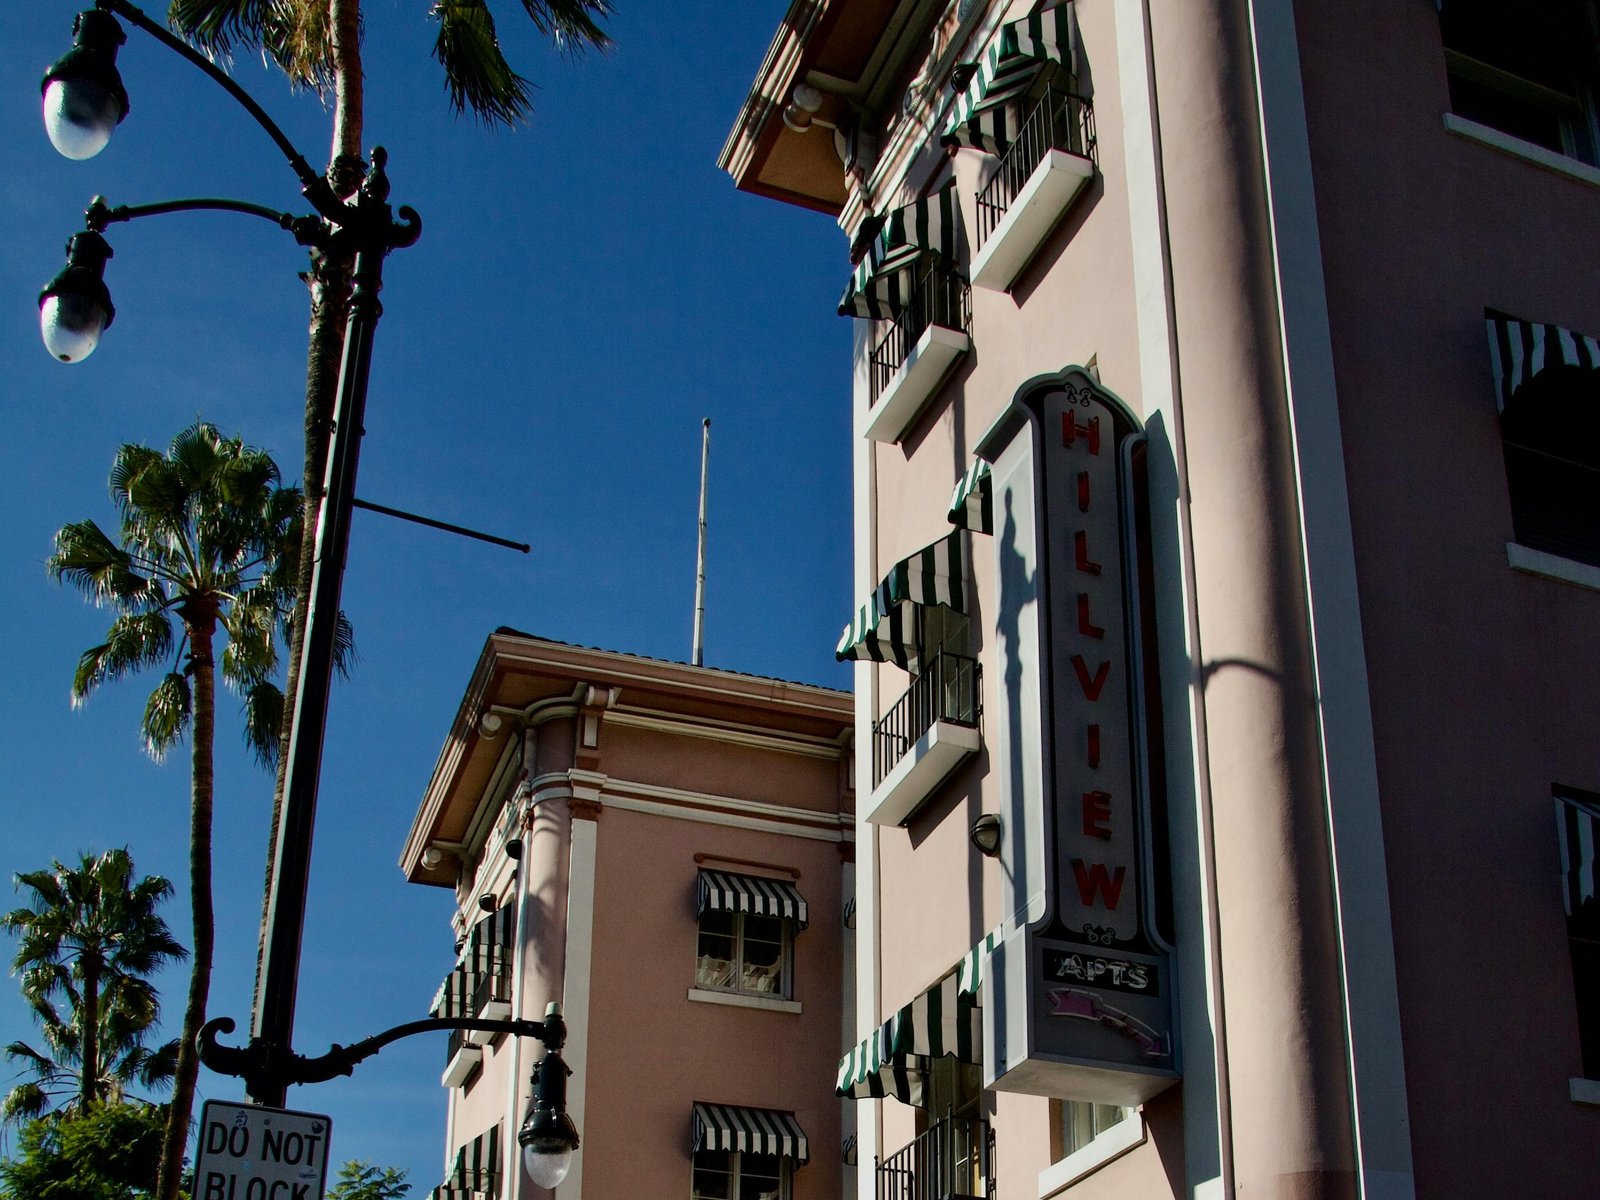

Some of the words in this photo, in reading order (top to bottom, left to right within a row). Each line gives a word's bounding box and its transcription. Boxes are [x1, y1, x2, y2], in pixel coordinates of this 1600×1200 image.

[1060, 408, 1125, 911] HILLVIEW
[1056, 954, 1149, 989] APTS
[206, 1121, 250, 1158] DO
[261, 1129, 321, 1166] NOT
